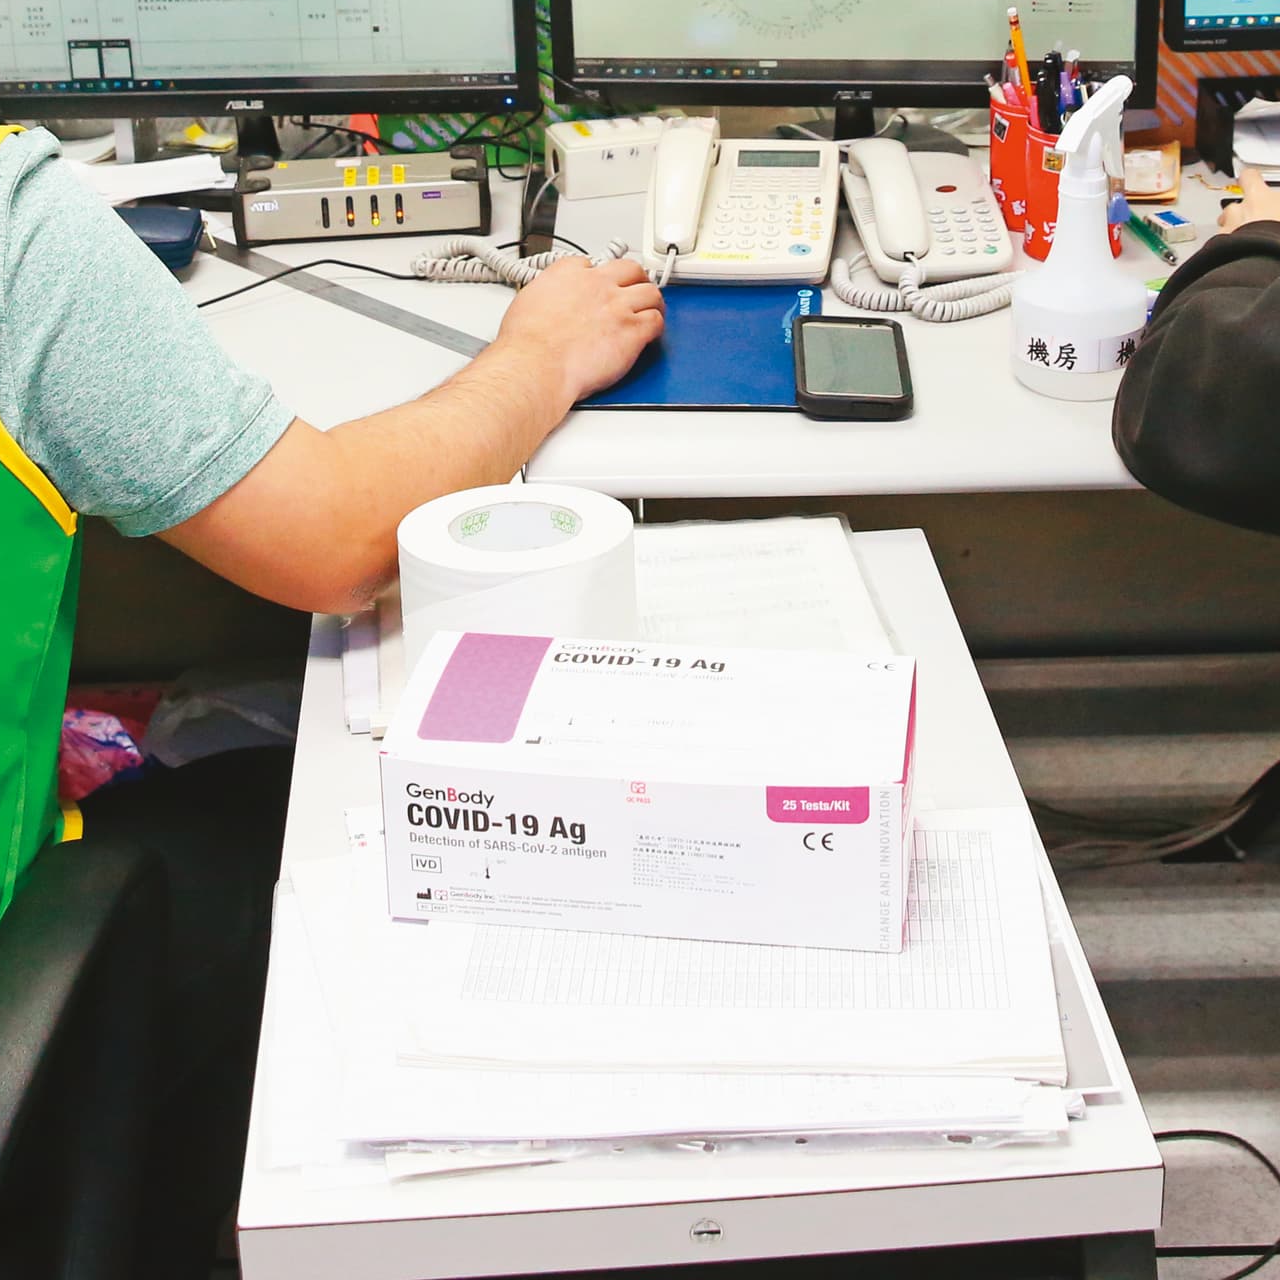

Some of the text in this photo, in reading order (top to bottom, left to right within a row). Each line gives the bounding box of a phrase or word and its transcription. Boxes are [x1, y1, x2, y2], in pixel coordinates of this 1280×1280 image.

[225, 100, 265, 110] ASUS
[250, 200, 279, 212] ATEN
[1026, 337, 1078, 371] 機房
[561, 642, 648, 655] GenBody
[553, 652, 726, 673] COVID-19 Ag
[406, 782, 495, 809] GenBody
[782, 800, 851, 812] 25 Tests/Kit
[406, 803, 587, 845] COVID-19 Ag
[408, 831, 608, 859] Detection of SARS-CoV-2 antigen
[414, 858, 438, 870] IVD
[879, 790, 891, 950] CHANGE AND INNOVATION
